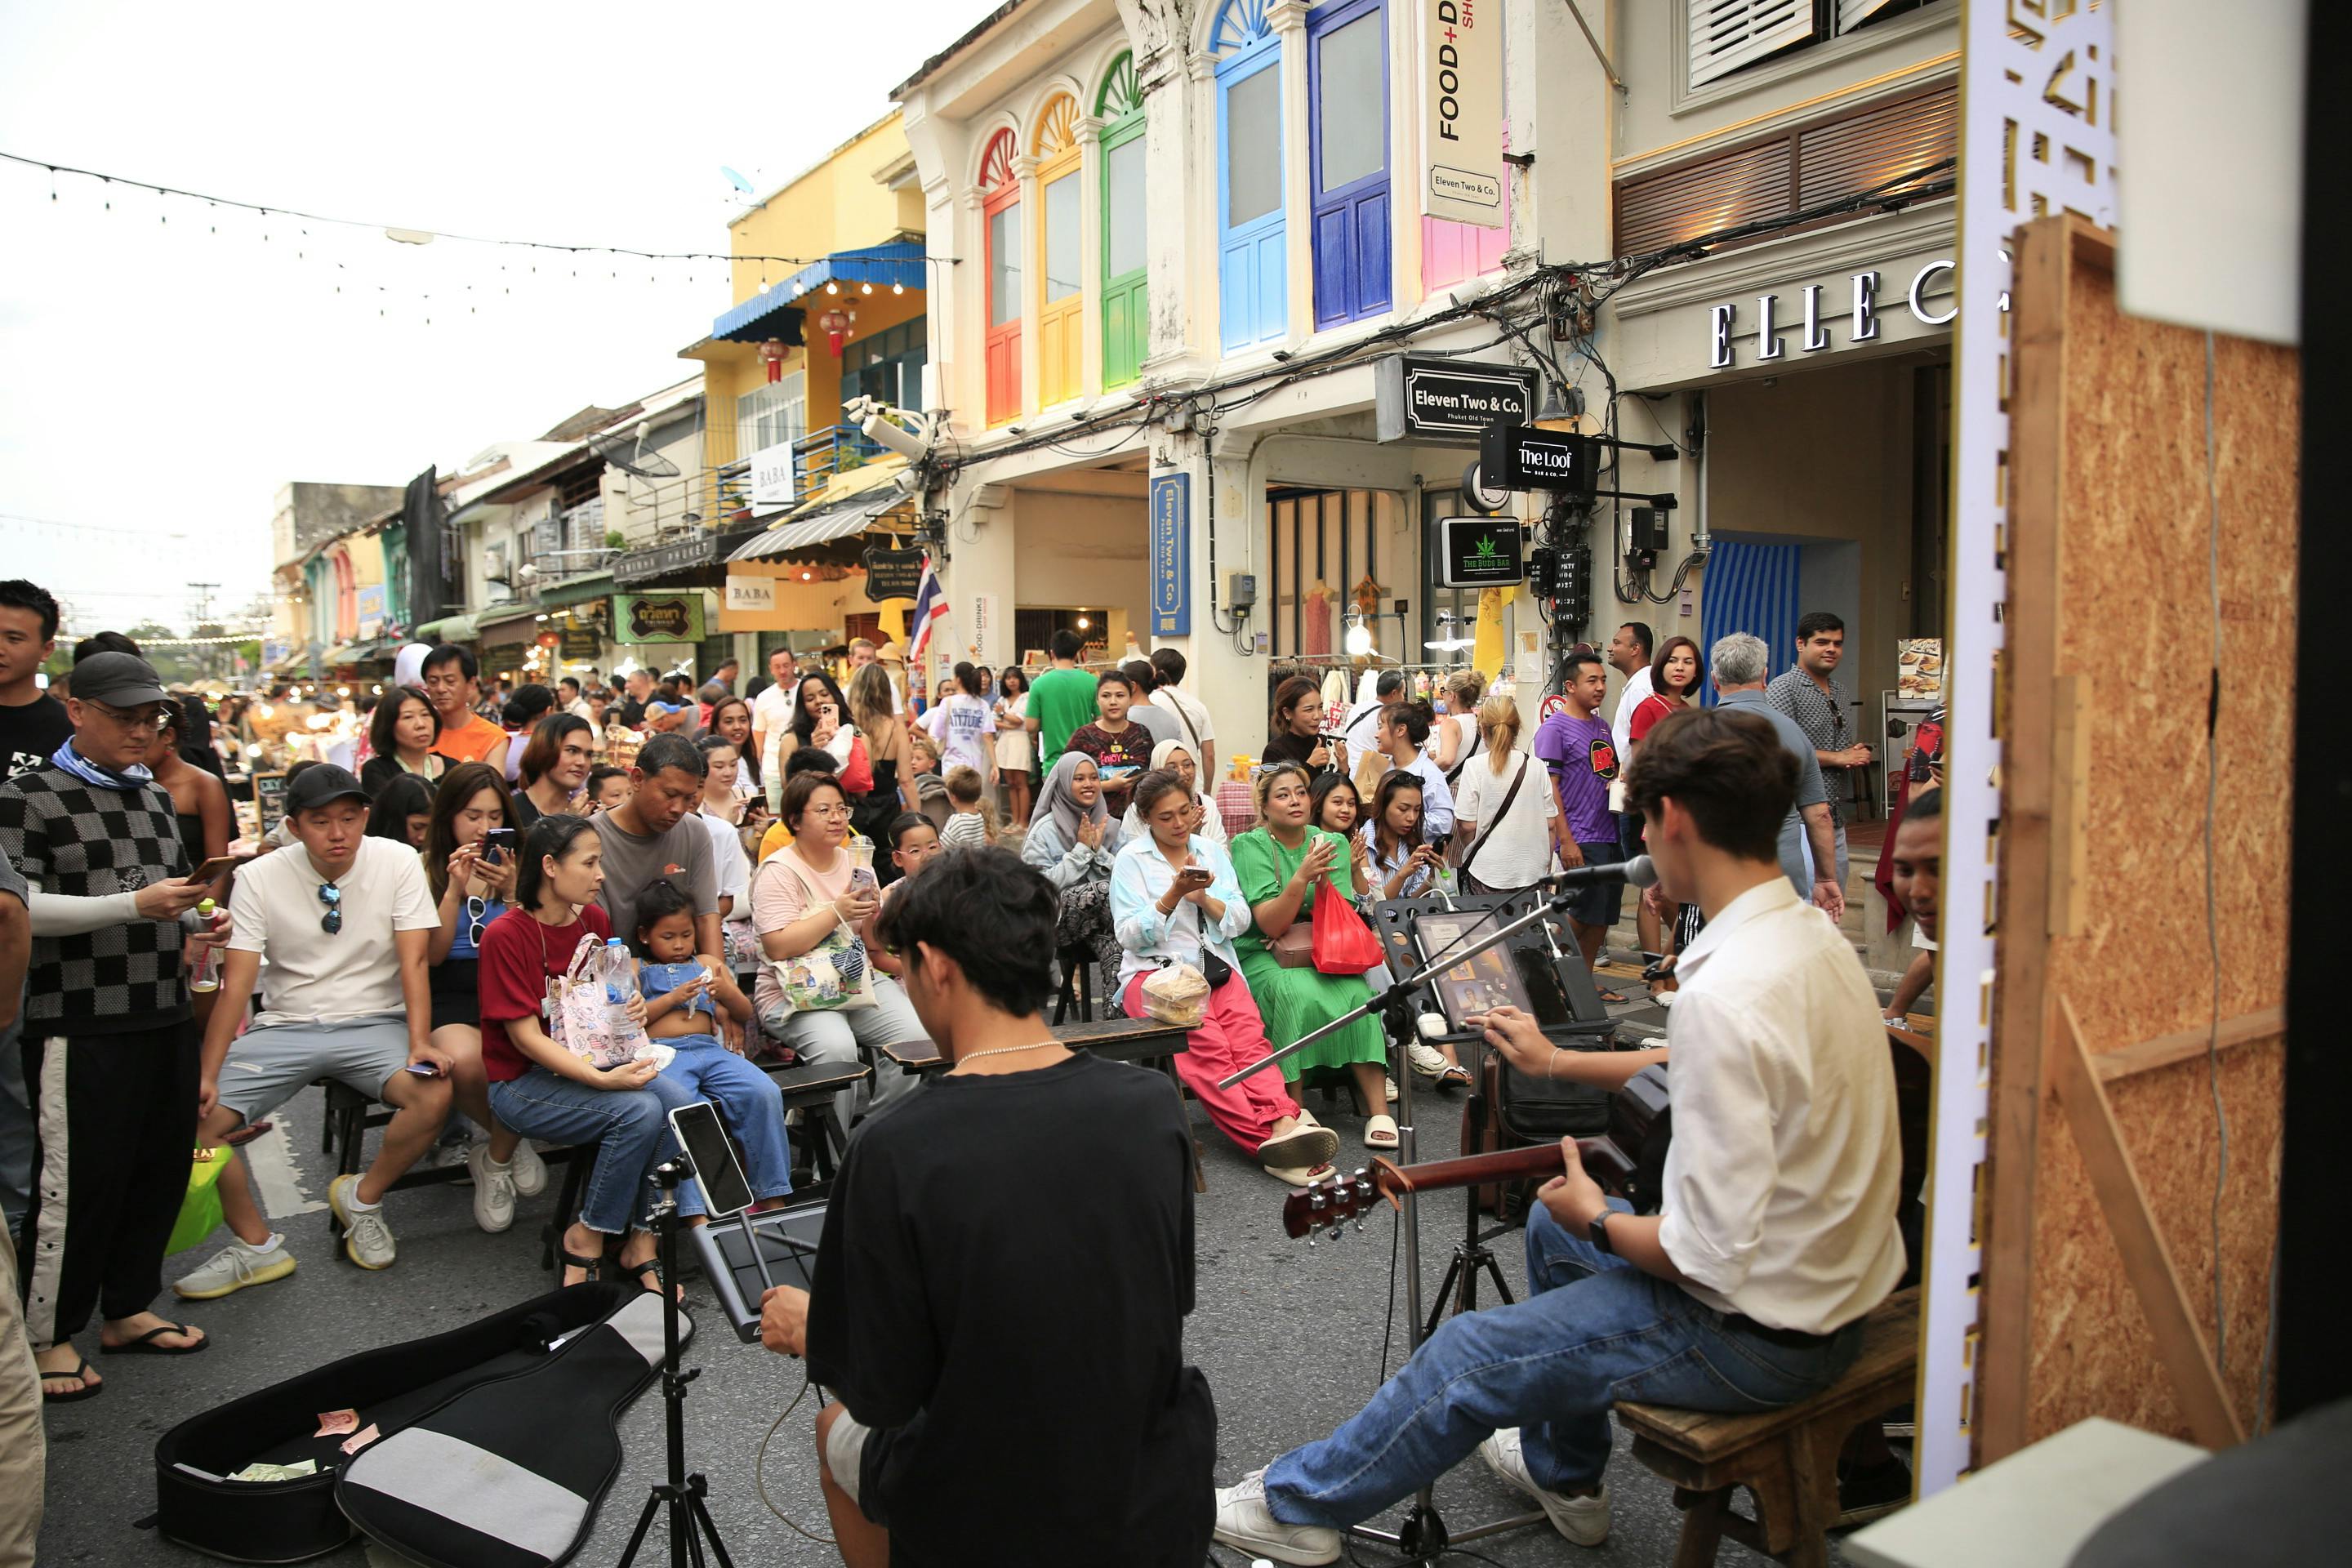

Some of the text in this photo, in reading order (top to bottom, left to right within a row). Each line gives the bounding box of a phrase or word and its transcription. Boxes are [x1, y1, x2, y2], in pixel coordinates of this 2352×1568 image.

[1463, 0, 1474, 29] SH
[1435, 176, 1459, 189] Eleven
[1461, 180, 1476, 192] Two
[1477, 185, 1483, 194] &
[1484, 185, 1495, 196] Co.
[1415, 390, 1522, 413] Eleven Two & Co.
[1447, 413, 1467, 422] Phuket
[1518, 449, 1572, 469] The Loof
[760, 466, 786, 488] BABA
[1166, 489, 1174, 536] Eleven
[668, 542, 708, 563] PHUKET
[1463, 559, 1477, 568] THE
[1166, 570, 1174, 580] &
[733, 587, 772, 599] BABA
[1166, 583, 1174, 605] Co.
